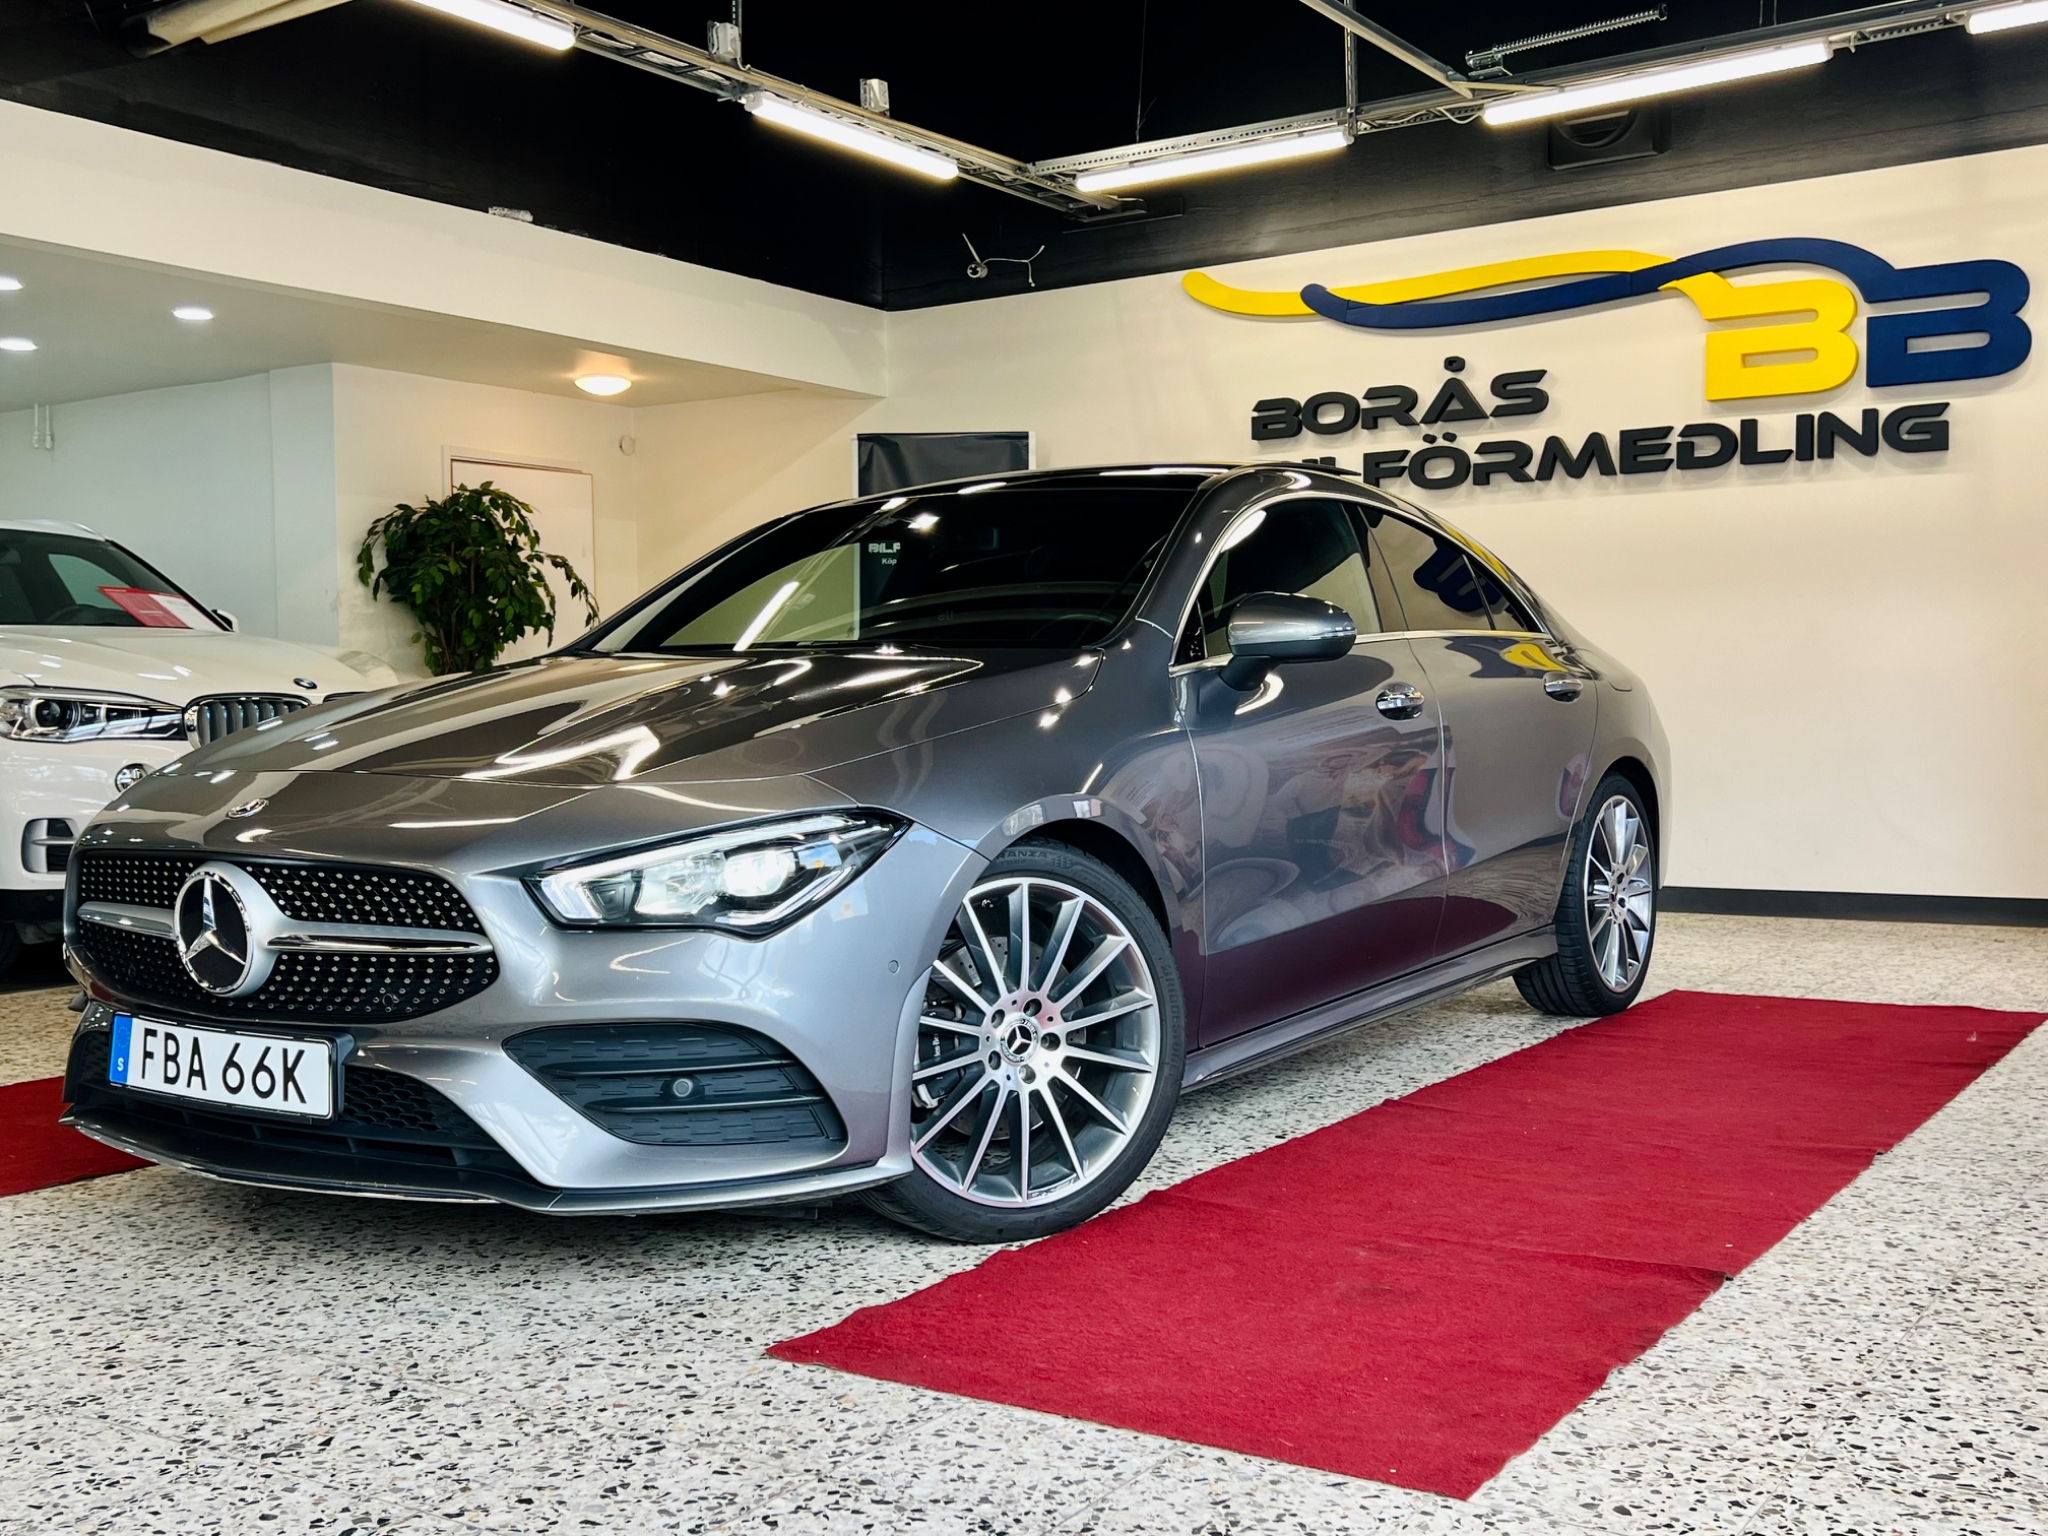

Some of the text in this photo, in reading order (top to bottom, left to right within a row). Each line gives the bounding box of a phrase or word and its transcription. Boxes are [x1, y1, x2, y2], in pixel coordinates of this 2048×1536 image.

[1251, 356, 1547, 441] BORÅS
[1301, 402, 1951, 491] FÖRMEDLING
[117, 1057, 125, 1072] S
[141, 1027, 307, 1104] FBA 66K
